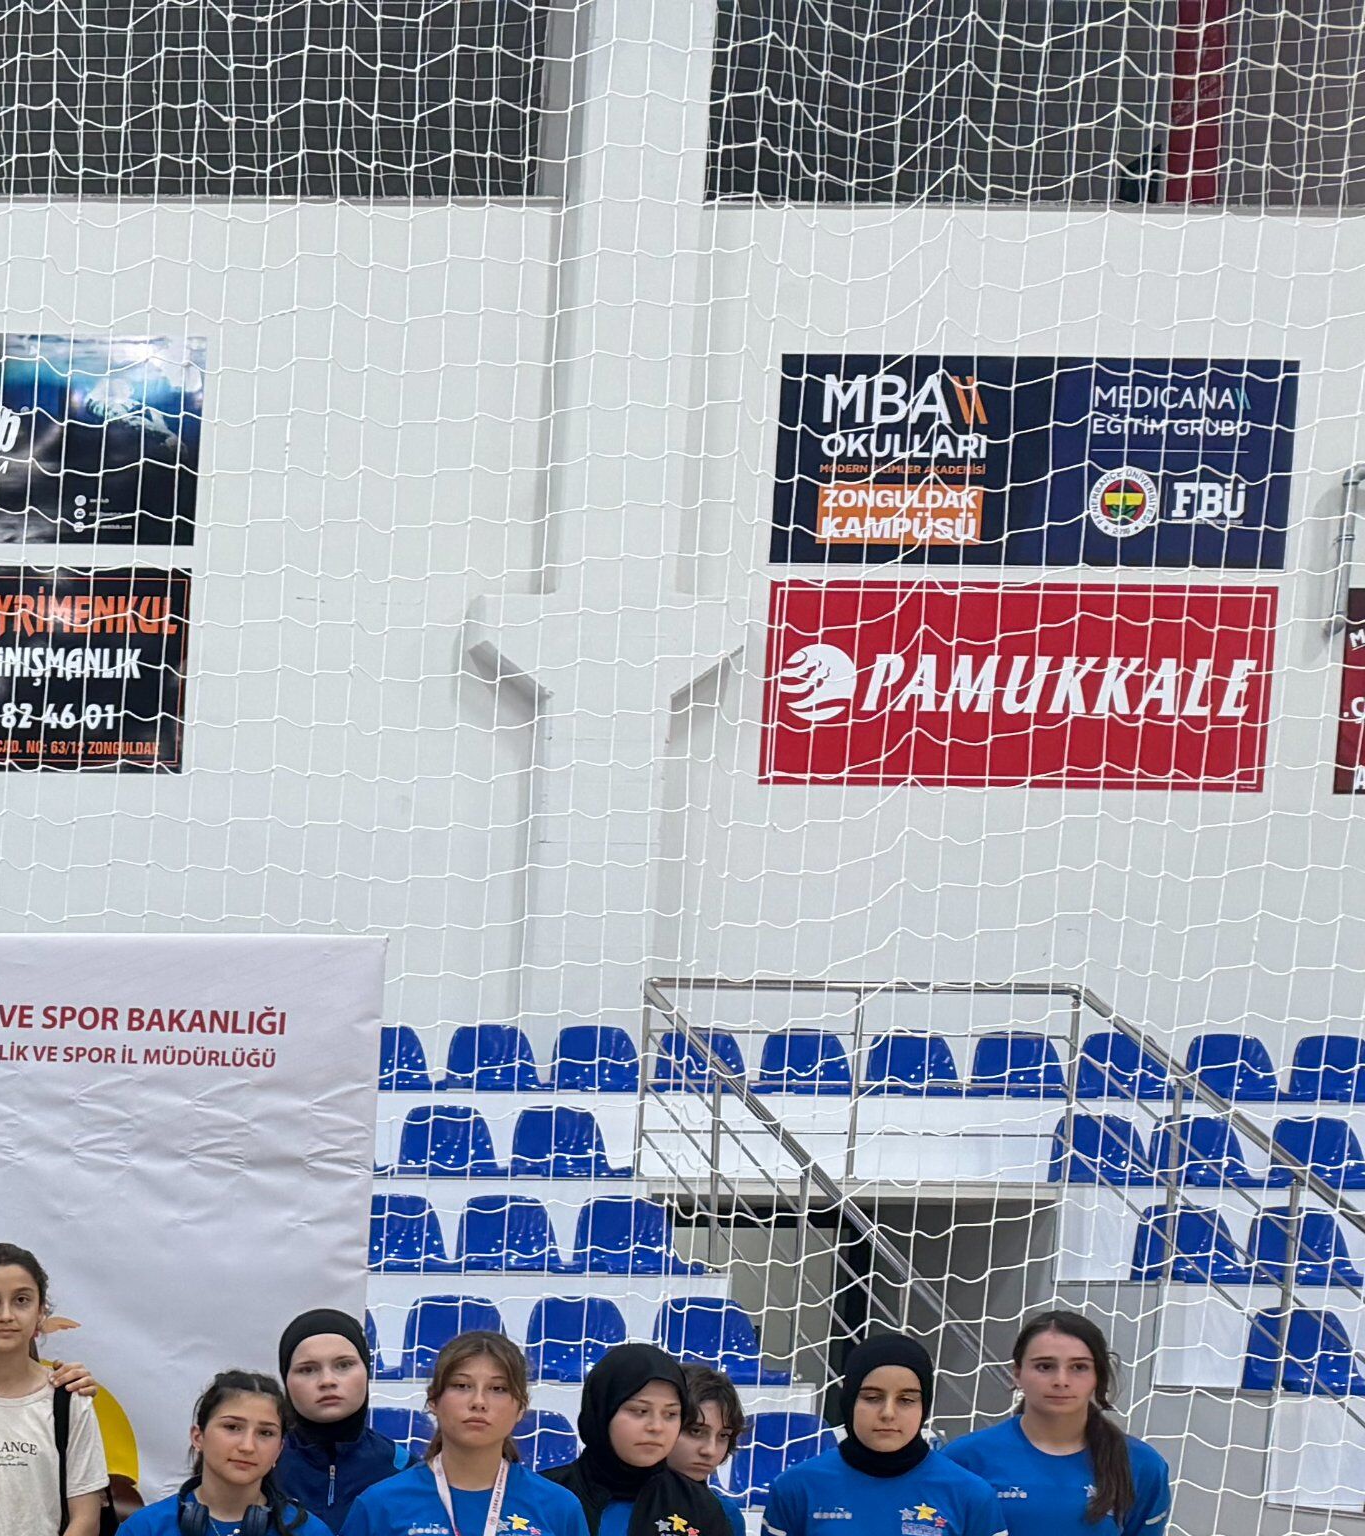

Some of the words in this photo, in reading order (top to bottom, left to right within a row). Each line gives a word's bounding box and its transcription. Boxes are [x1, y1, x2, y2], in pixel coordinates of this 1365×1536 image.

[1094, 386, 1236, 410] MEDICANA
[1173, 418, 1251, 436] GRUBU
[821, 433, 987, 459] OKULLARI
[822, 489, 978, 509] ZONGULDAK
[1171, 482, 1246, 519] FBÜ
[821, 512, 977, 540] KAMPÜSÜ
[859, 653, 1258, 718] PAMUKKALE
[43, 703, 74, 730] 46
[85, 704, 116, 730] 01
[41, 1006, 118, 1032] SPOR
[126, 1005, 286, 1036] BAKANLIĞI
[32, 1046, 58, 1062] VE
[63, 1047, 116, 1064] SPOR
[121, 1044, 139, 1065] İL
[143, 1045, 277, 1069] MÜDÜRLÜĞÜ
